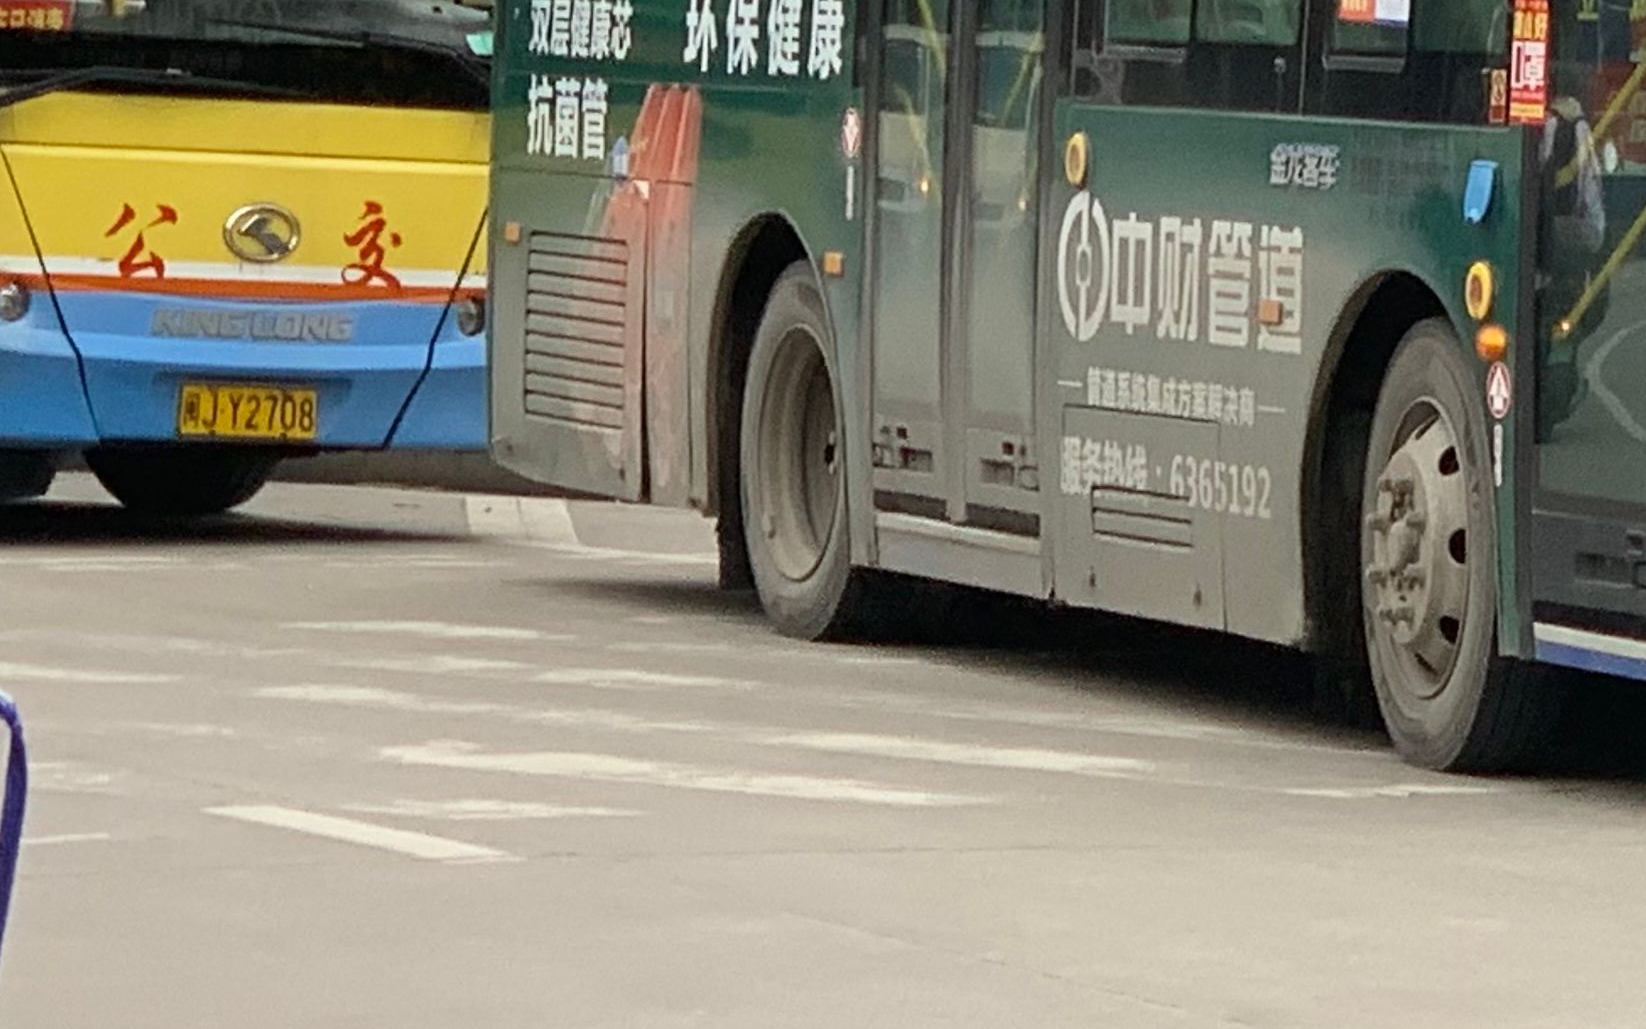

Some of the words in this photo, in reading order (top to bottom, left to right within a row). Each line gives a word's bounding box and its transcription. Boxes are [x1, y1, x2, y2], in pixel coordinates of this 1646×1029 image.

[526, 73, 609, 160] 抗菌管
[104, 201, 179, 280] 公
[340, 200, 403, 290] 交
[1109, 210, 1304, 354] 中财管道
